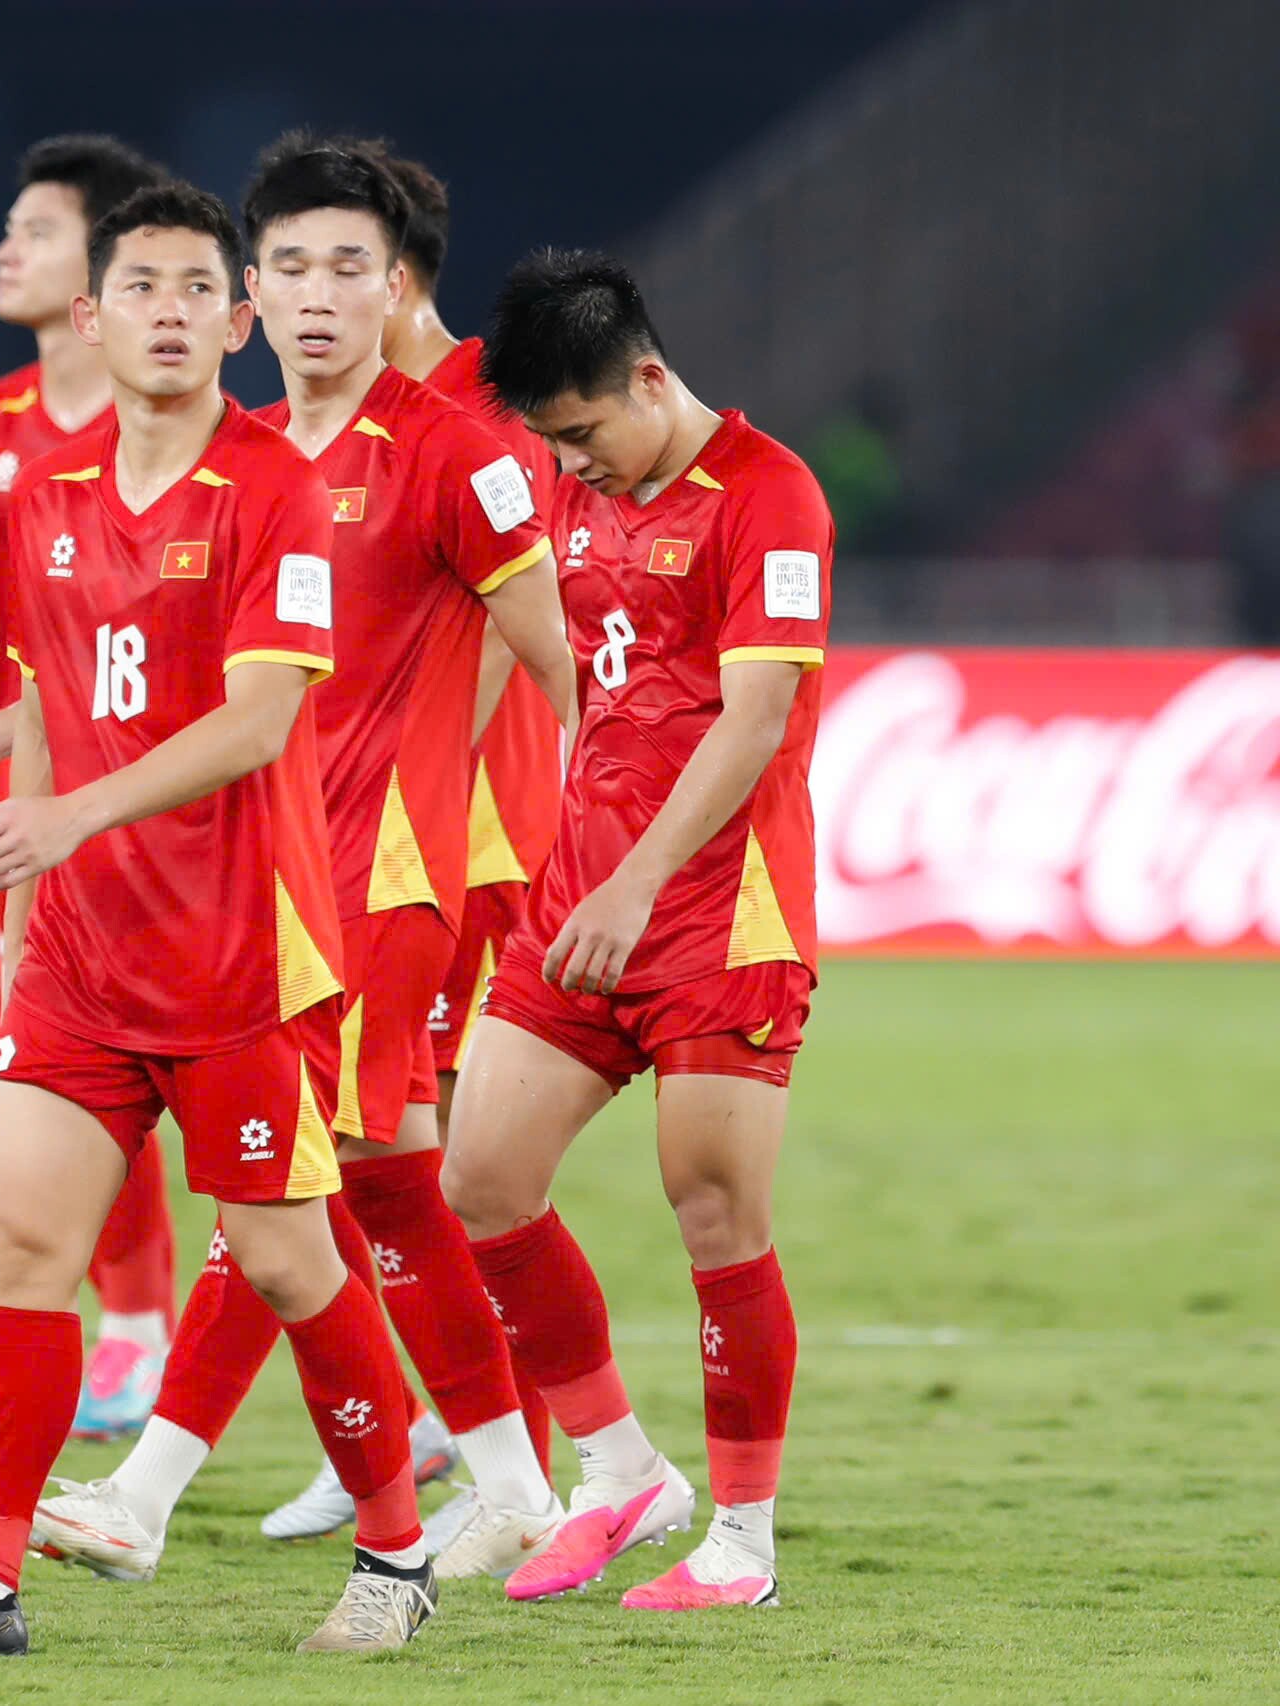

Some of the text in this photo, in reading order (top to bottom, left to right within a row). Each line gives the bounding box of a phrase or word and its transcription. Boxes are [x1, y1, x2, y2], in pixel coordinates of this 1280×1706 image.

[290, 577, 323, 595] UNITES
[776, 572, 809, 588] UNITES
[91, 622, 148, 722] 18
[592, 608, 637, 692] 8
[808, 651, 1280, 947] Coca-Co
